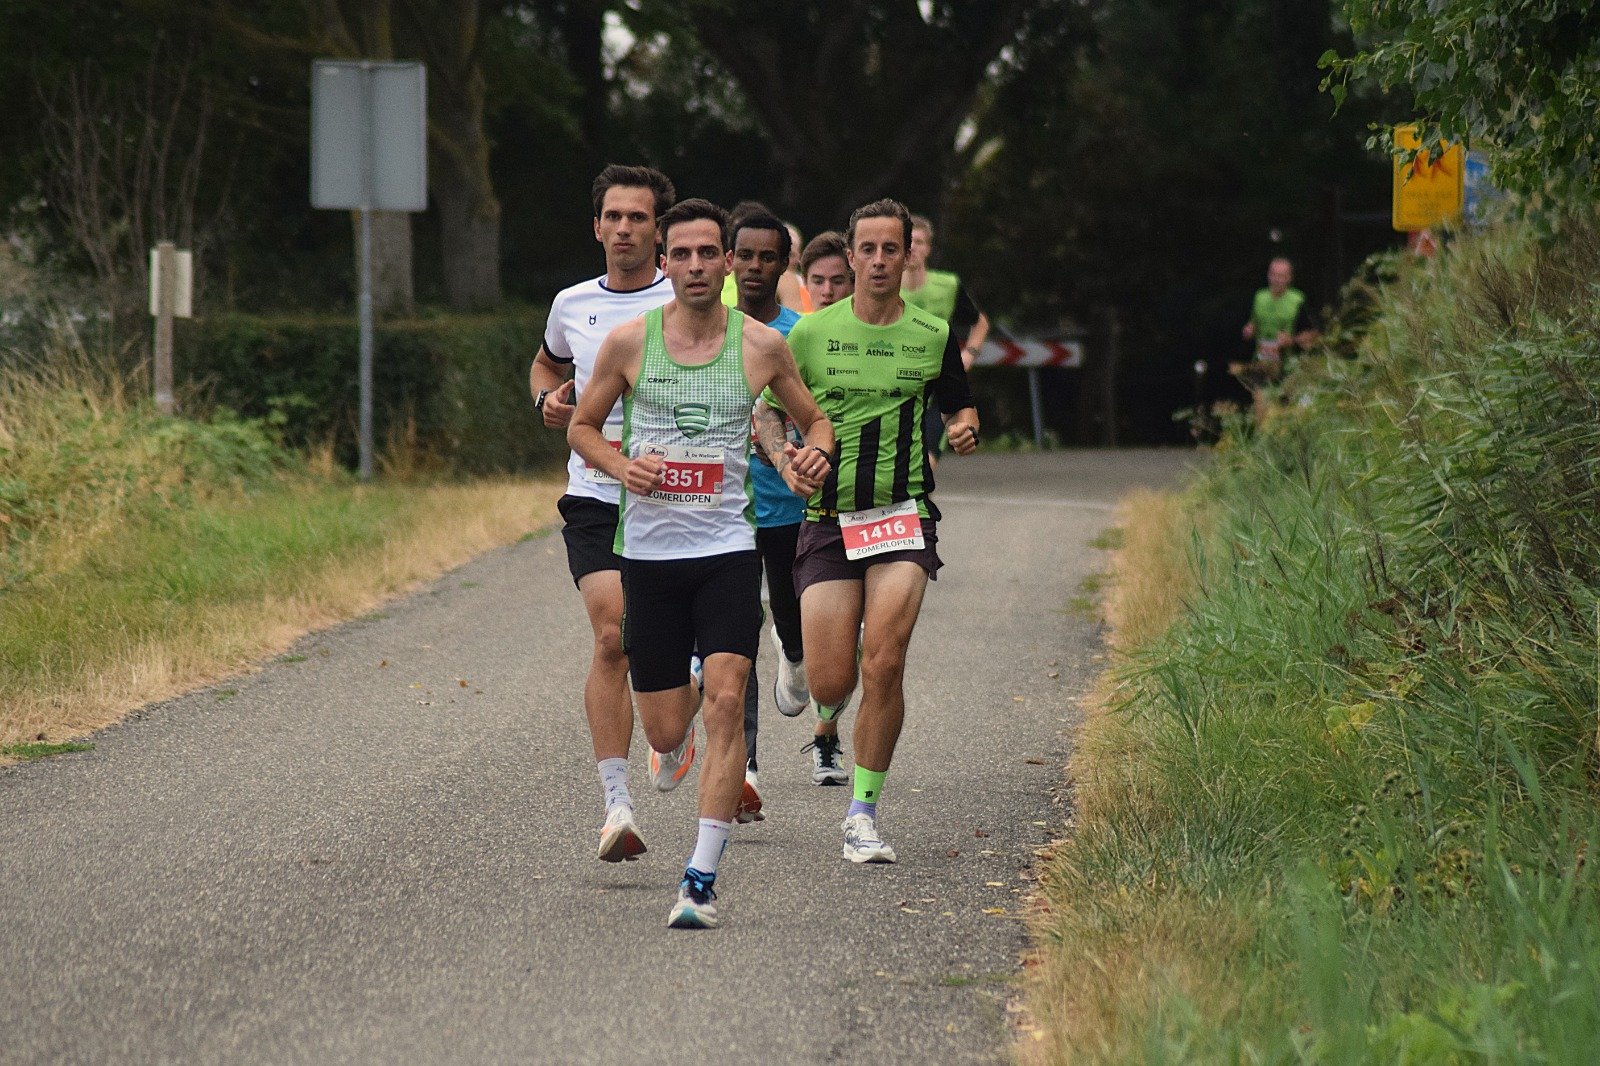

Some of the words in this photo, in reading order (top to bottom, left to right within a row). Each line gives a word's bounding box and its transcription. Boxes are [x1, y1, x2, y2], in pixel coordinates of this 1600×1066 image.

[866, 348, 894, 357] Athlex
[859, 521, 906, 543] 1416
[856, 538, 915, 555] ZOMERLOPEN
